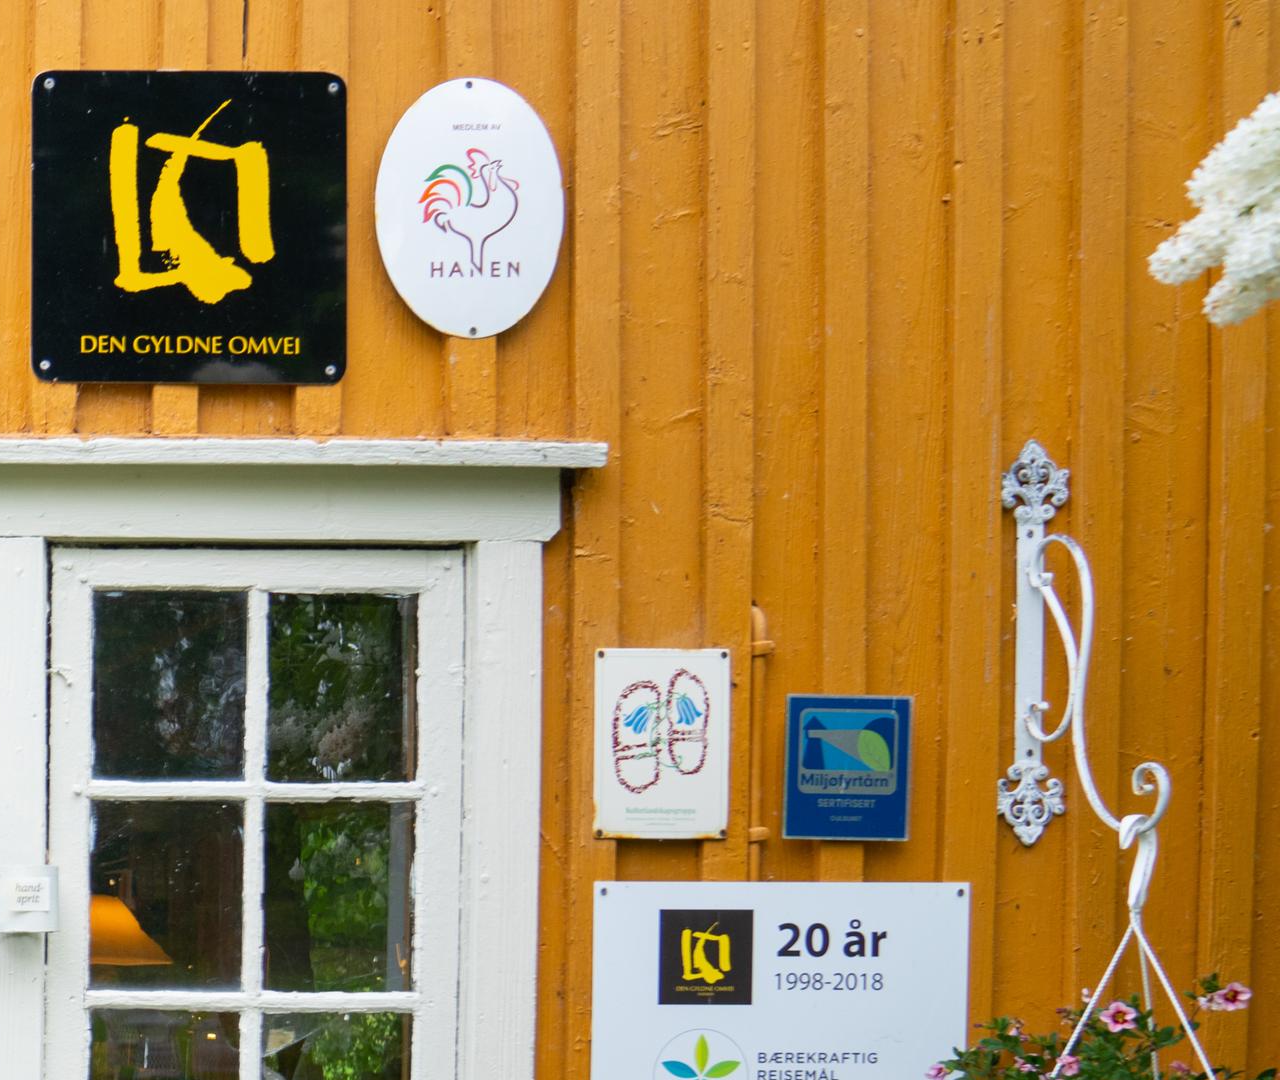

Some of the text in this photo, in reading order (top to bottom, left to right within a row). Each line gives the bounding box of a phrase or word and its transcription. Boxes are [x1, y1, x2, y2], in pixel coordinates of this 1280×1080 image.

[452, 123, 501, 131] MEDLEM AV
[430, 260, 521, 278] HANEN
[80, 334, 301, 356] DEN GYLDNE OMVEI
[800, 773, 889, 790] Miljøfyrtårn
[816, 798, 877, 809] SERTIFISERT
[15, 882, 44, 892] hand-
[776, 918, 888, 958] 20 år
[774, 972, 884, 991] 1998-2018
[757, 1051, 879, 1064] BÆREKRAFTIG
